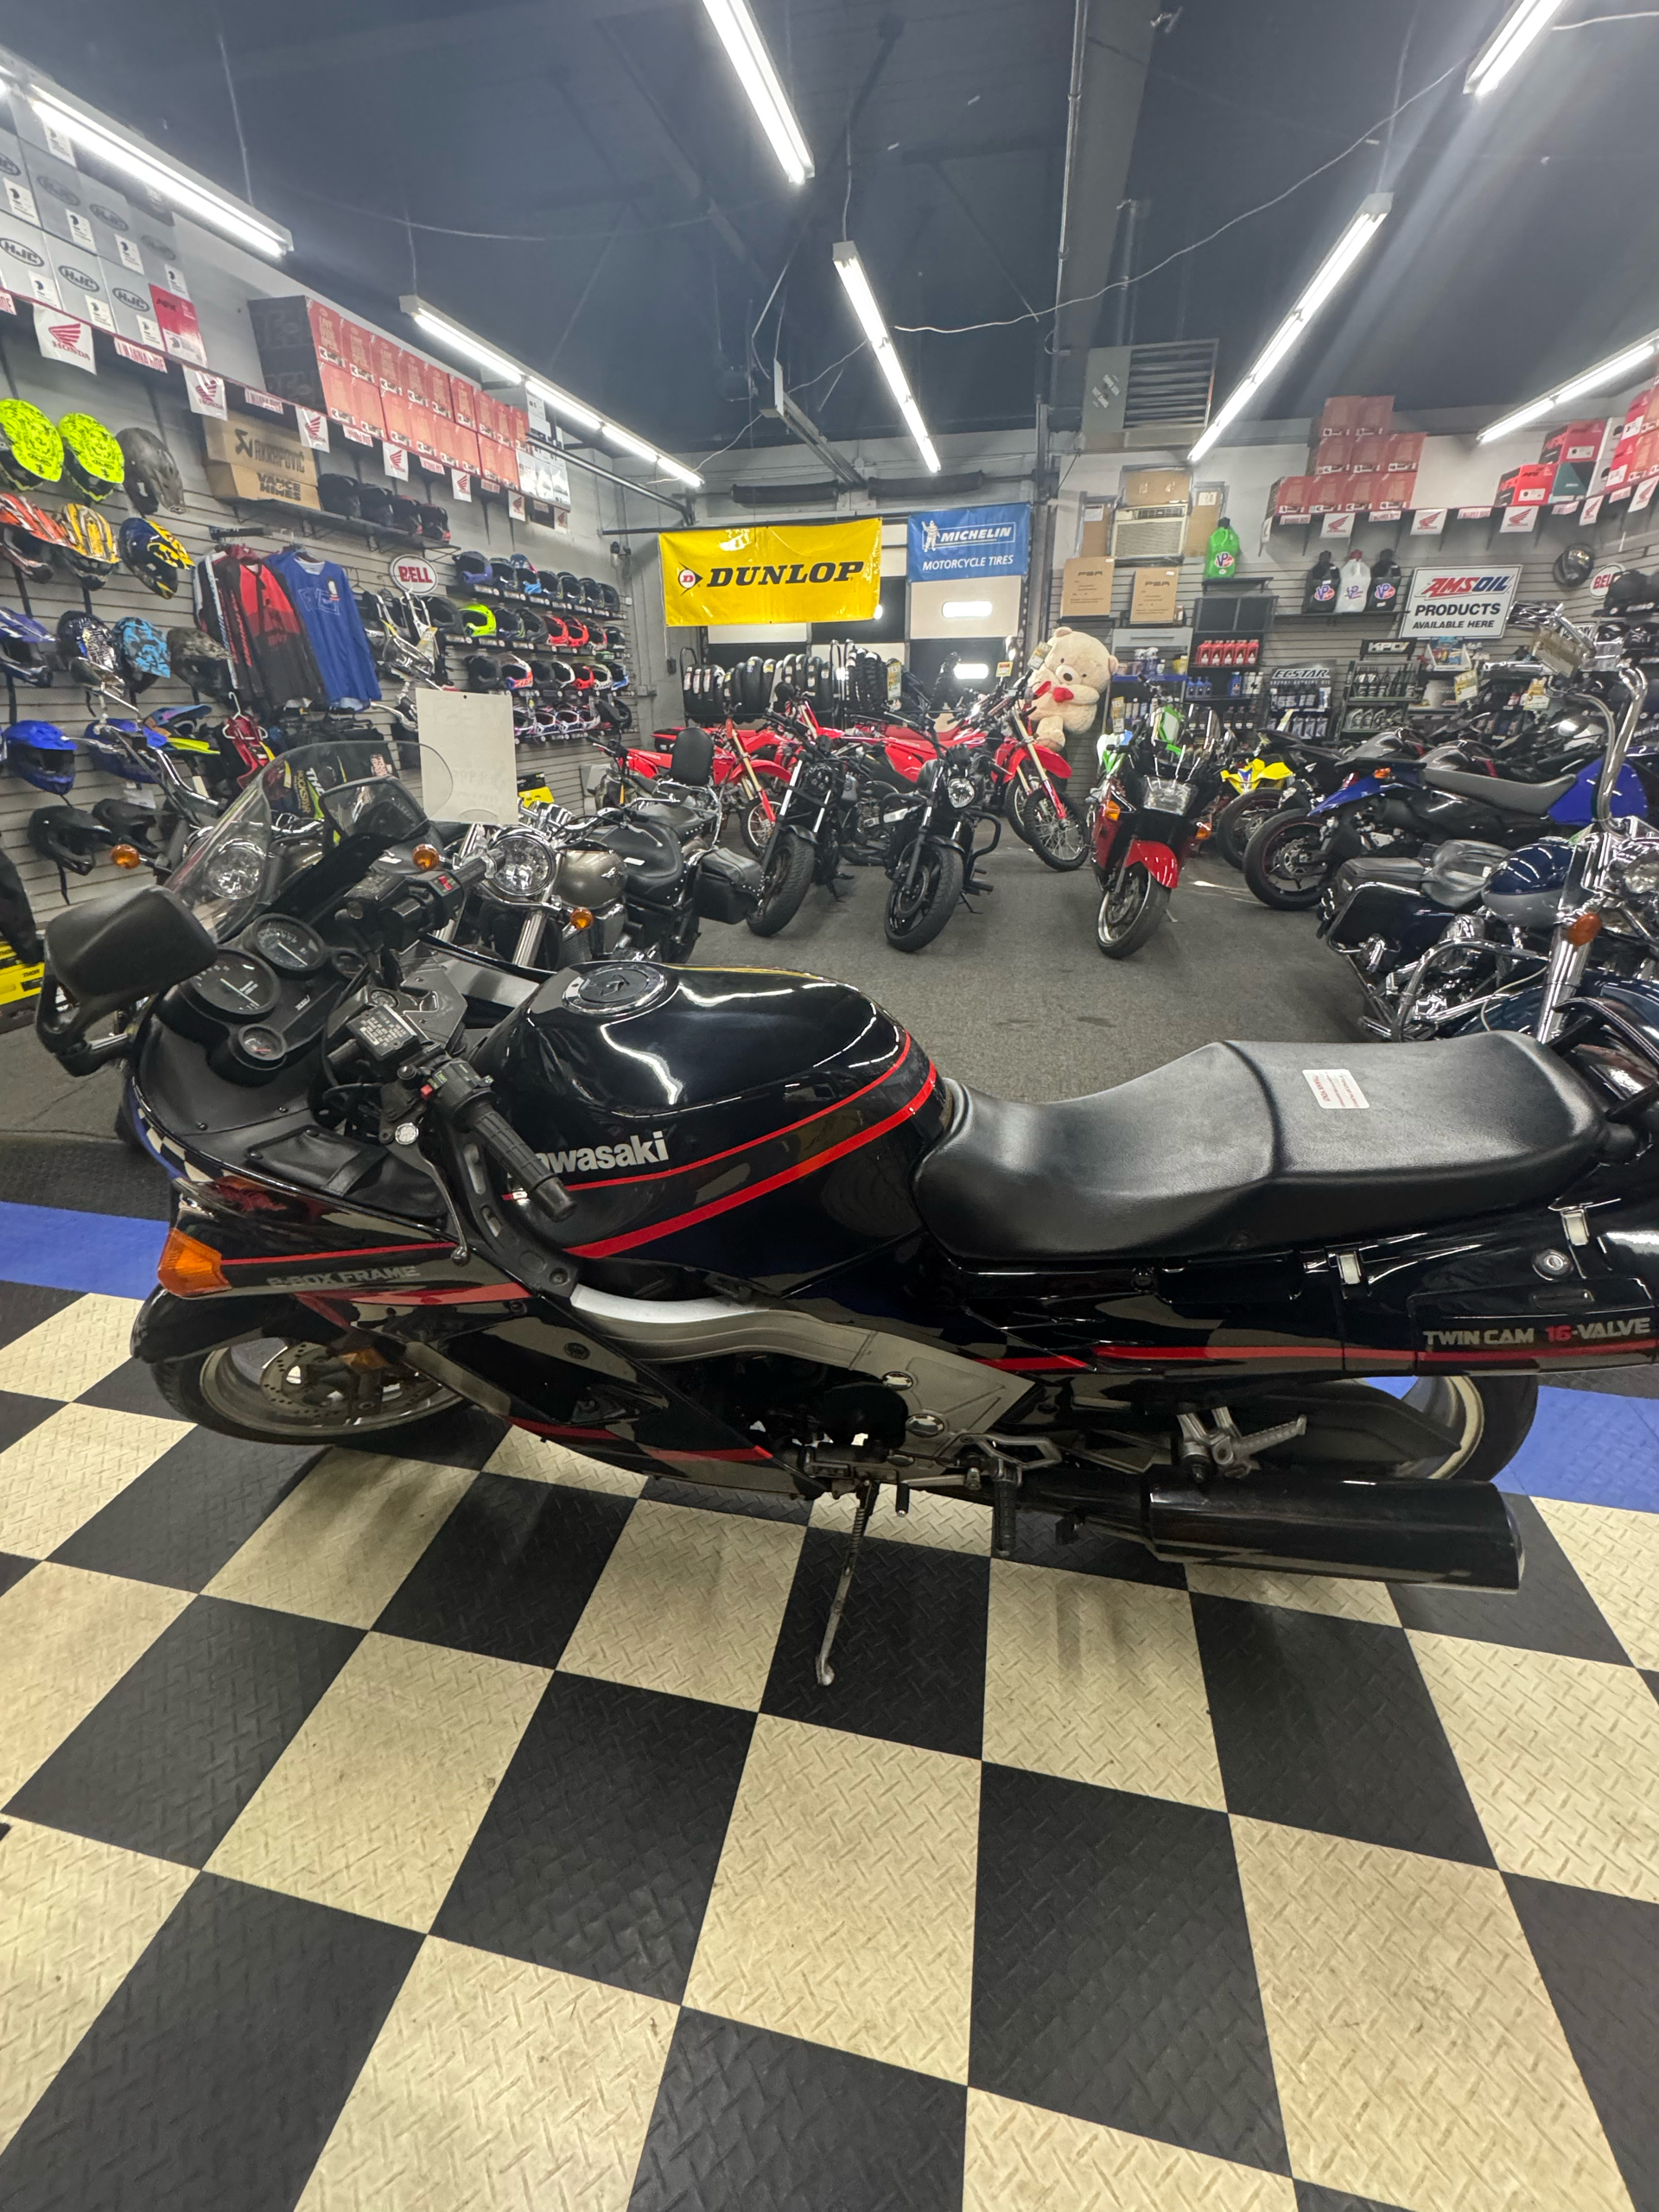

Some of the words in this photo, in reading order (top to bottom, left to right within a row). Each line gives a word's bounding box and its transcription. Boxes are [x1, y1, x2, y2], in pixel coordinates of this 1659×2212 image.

[4, 241, 38, 264] HJC
[65, 269, 93, 289] HJC
[118, 291, 145, 308] HJC
[52, 340, 90, 361] HONDA
[260, 482, 302, 501] HINES
[940, 527, 1012, 543] MICHELIN
[922, 556, 987, 570] MOTORCYCLE
[988, 555, 1014, 566] TIRES
[1217, 553, 1229, 567] VP
[398, 566, 434, 583] BELL
[707, 562, 864, 587] DUNLOP
[1592, 574, 1612, 589] BEL
[1318, 585, 1330, 600] VP
[1377, 584, 1390, 598] VP
[1421, 576, 1510, 598] AMSOIL
[1414, 603, 1501, 616] PRODUCTS
[1467, 620, 1495, 628] HERE
[1273, 669, 1330, 678] ECSTAR
[638, 751, 661, 760] HONDA
[535, 1131, 670, 1173] wasaki
[340, 1265, 421, 1282] FRAME
[1422, 1330, 1480, 1345] TWIN
[1484, 1328, 1535, 1344] CAM
[1546, 1318, 1651, 1342] 16-VALVE
